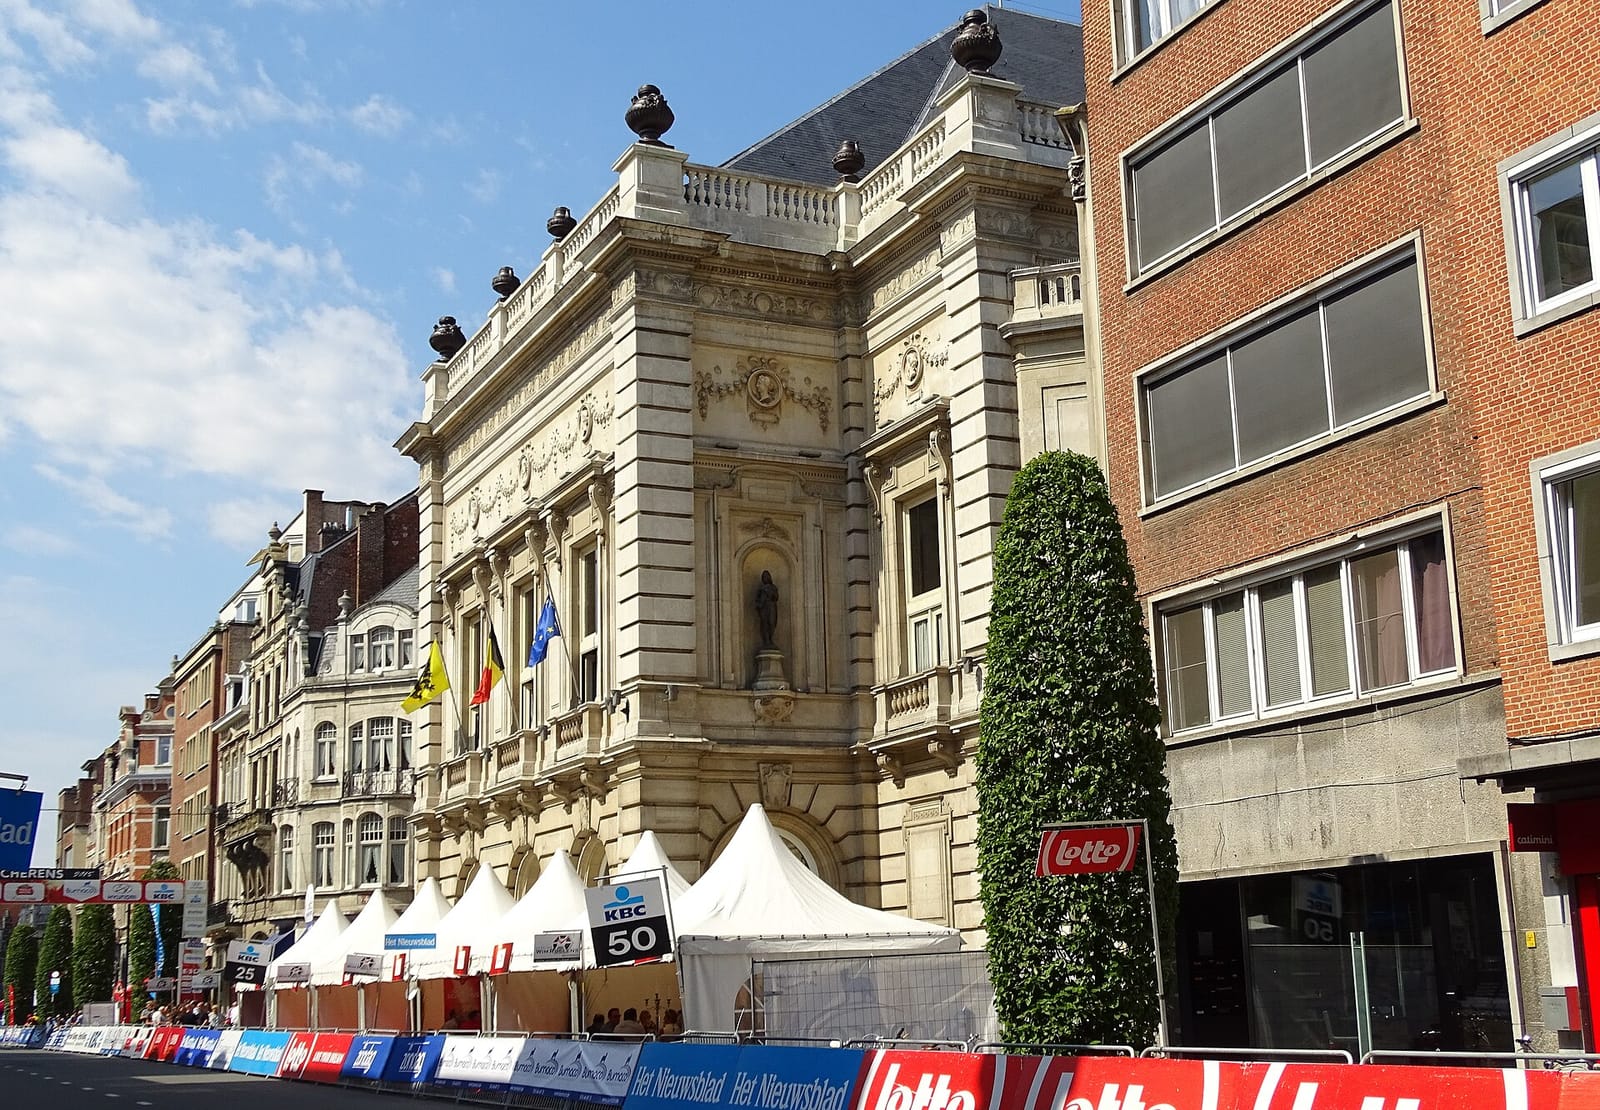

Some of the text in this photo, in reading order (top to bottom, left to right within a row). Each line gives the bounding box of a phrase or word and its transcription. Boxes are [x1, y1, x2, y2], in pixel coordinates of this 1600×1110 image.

[1517, 835, 1553, 844] catimini
[604, 904, 647, 922] KBC
[608, 926, 657, 956] 50
[234, 966, 256, 981] 25
[631, 1066, 655, 1097] Het
[652, 1067, 727, 1104] Nieuwsblad
[729, 1072, 849, 1110] Het Nieuwsblad
